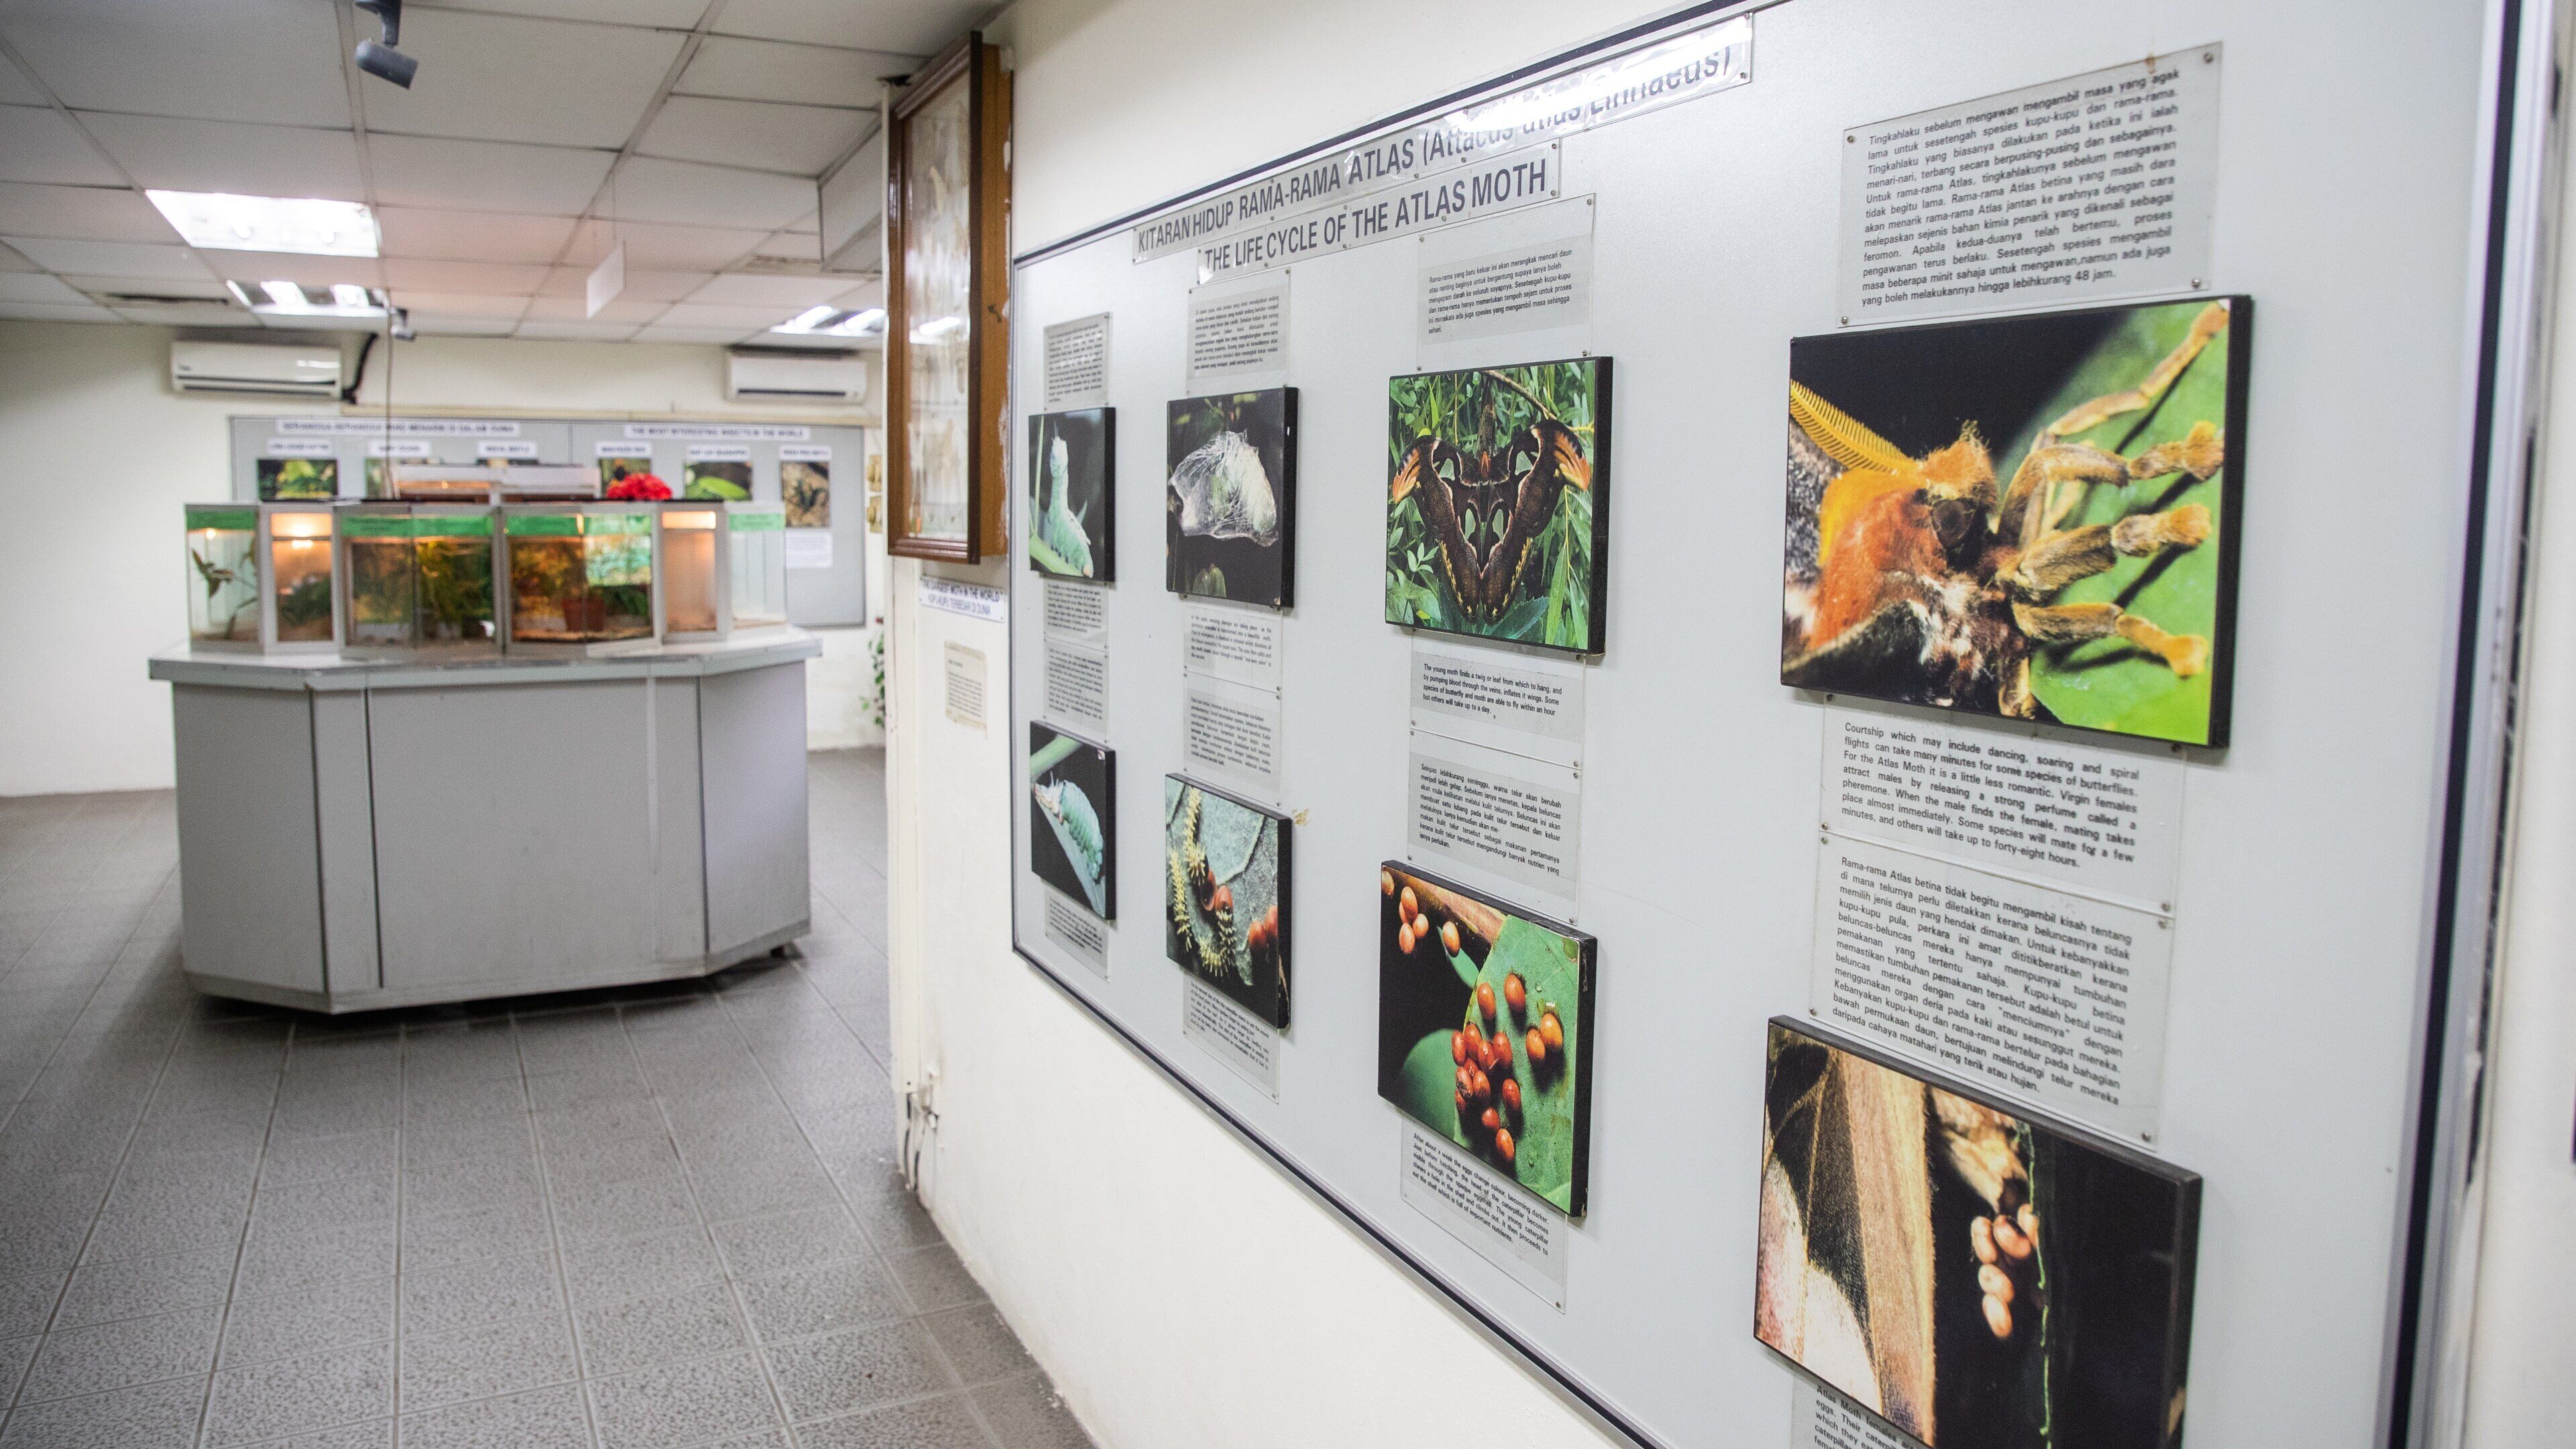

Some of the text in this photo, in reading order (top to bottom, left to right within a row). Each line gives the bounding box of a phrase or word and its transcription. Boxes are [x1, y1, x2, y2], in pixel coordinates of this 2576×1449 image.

[1868, 89, 2178, 160] lama untuk sesetengah spesies kupu-kupu dan rama-rama.
[1869, 69, 2179, 144] Tingkahlaku sebelum mengawan mengambil masa yang agak
[1868, 104, 2178, 174] Tingkahlaku yang biasanya dilakukan pada ketika ini ialah
[1138, 215, 1190, 253] KITARAN
[1193, 201, 1234, 237] HIDUP
[1239, 163, 1341, 221] RAMA-RAMA
[1348, 138, 1414, 184] ATLAS
[1205, 158, 1546, 272] THE LIFE CYCLE OF THE ATLAS MOTH
[1429, 274, 1452, 283] Rama-rama
[1454, 272, 1464, 280] yang
[1510, 256, 1536, 267] merangkak
[1538, 251, 1558, 261] mencari
[1424, 663, 1432, 671] The
[1432, 666, 1446, 675] young
[1459, 669, 1470, 678] finds
[1474, 673, 1485, 682] twig
[1502, 677, 1513, 686] from
[1514, 680, 1529, 688] which
[1536, 683, 1550, 694] hang,
[1430, 676, 1448, 685] pumping
[1448, 678, 1461, 686] blood
[1462, 680, 1479, 690] through
[1489, 686, 1502, 694] veins,
[1503, 688, 1521, 698] inflates
[1527, 693, 1543, 703] wings.
[1544, 696, 1559, 705] Some
[1844, 736, 2137, 796] flights can take many minutes for some species of butterflies.
[1845, 722, 2139, 780] Courtship which may include dancing, soaring and spiral
[1420, 774, 1436, 784] menjadi
[1438, 777, 1448, 787] lebih
[1464, 786, 1483, 796] Sebelum
[1484, 791, 1497, 801] ianya
[1498, 797, 1519, 808] menetas,
[1521, 802, 1537, 812] kepala
[1538, 806, 1561, 819] beluncas
[1466, 777, 1489, 789] seminggu,
[1511, 789, 1522, 797] telur
[1525, 793, 1537, 802] akan
[1540, 796, 1561, 808] berubah
[1843, 749, 1856, 760] For
[1860, 754, 1873, 763] the
[1877, 756, 1898, 768] Atlas
[1902, 761, 1925, 773] Moth
[1929, 765, 1935, 775] it
[1939, 767, 1947, 777] is
[1960, 771, 1980, 784] little
[1984, 776, 2003, 788] less
[2008, 782, 2053, 798] romantic.
[2059, 790, 2090, 805] Virgin
[2095, 796, 2137, 813] females
[1840, 871, 2129, 959] di mana telurnya perlu diletakkan kerana beluncasnya tidak
[1841, 856, 2131, 946] Rama-rama Atlas betina tidak begitu mengambil kisah tentang
[1815, 1412, 1858, 1446] which they
[1816, 1399, 1862, 1433] eggs. Their
[1817, 1385, 1837, 1404] Atlas
[1841, 1399, 1862, 1420] Moth
[1866, 1416, 1897, 1443] females
